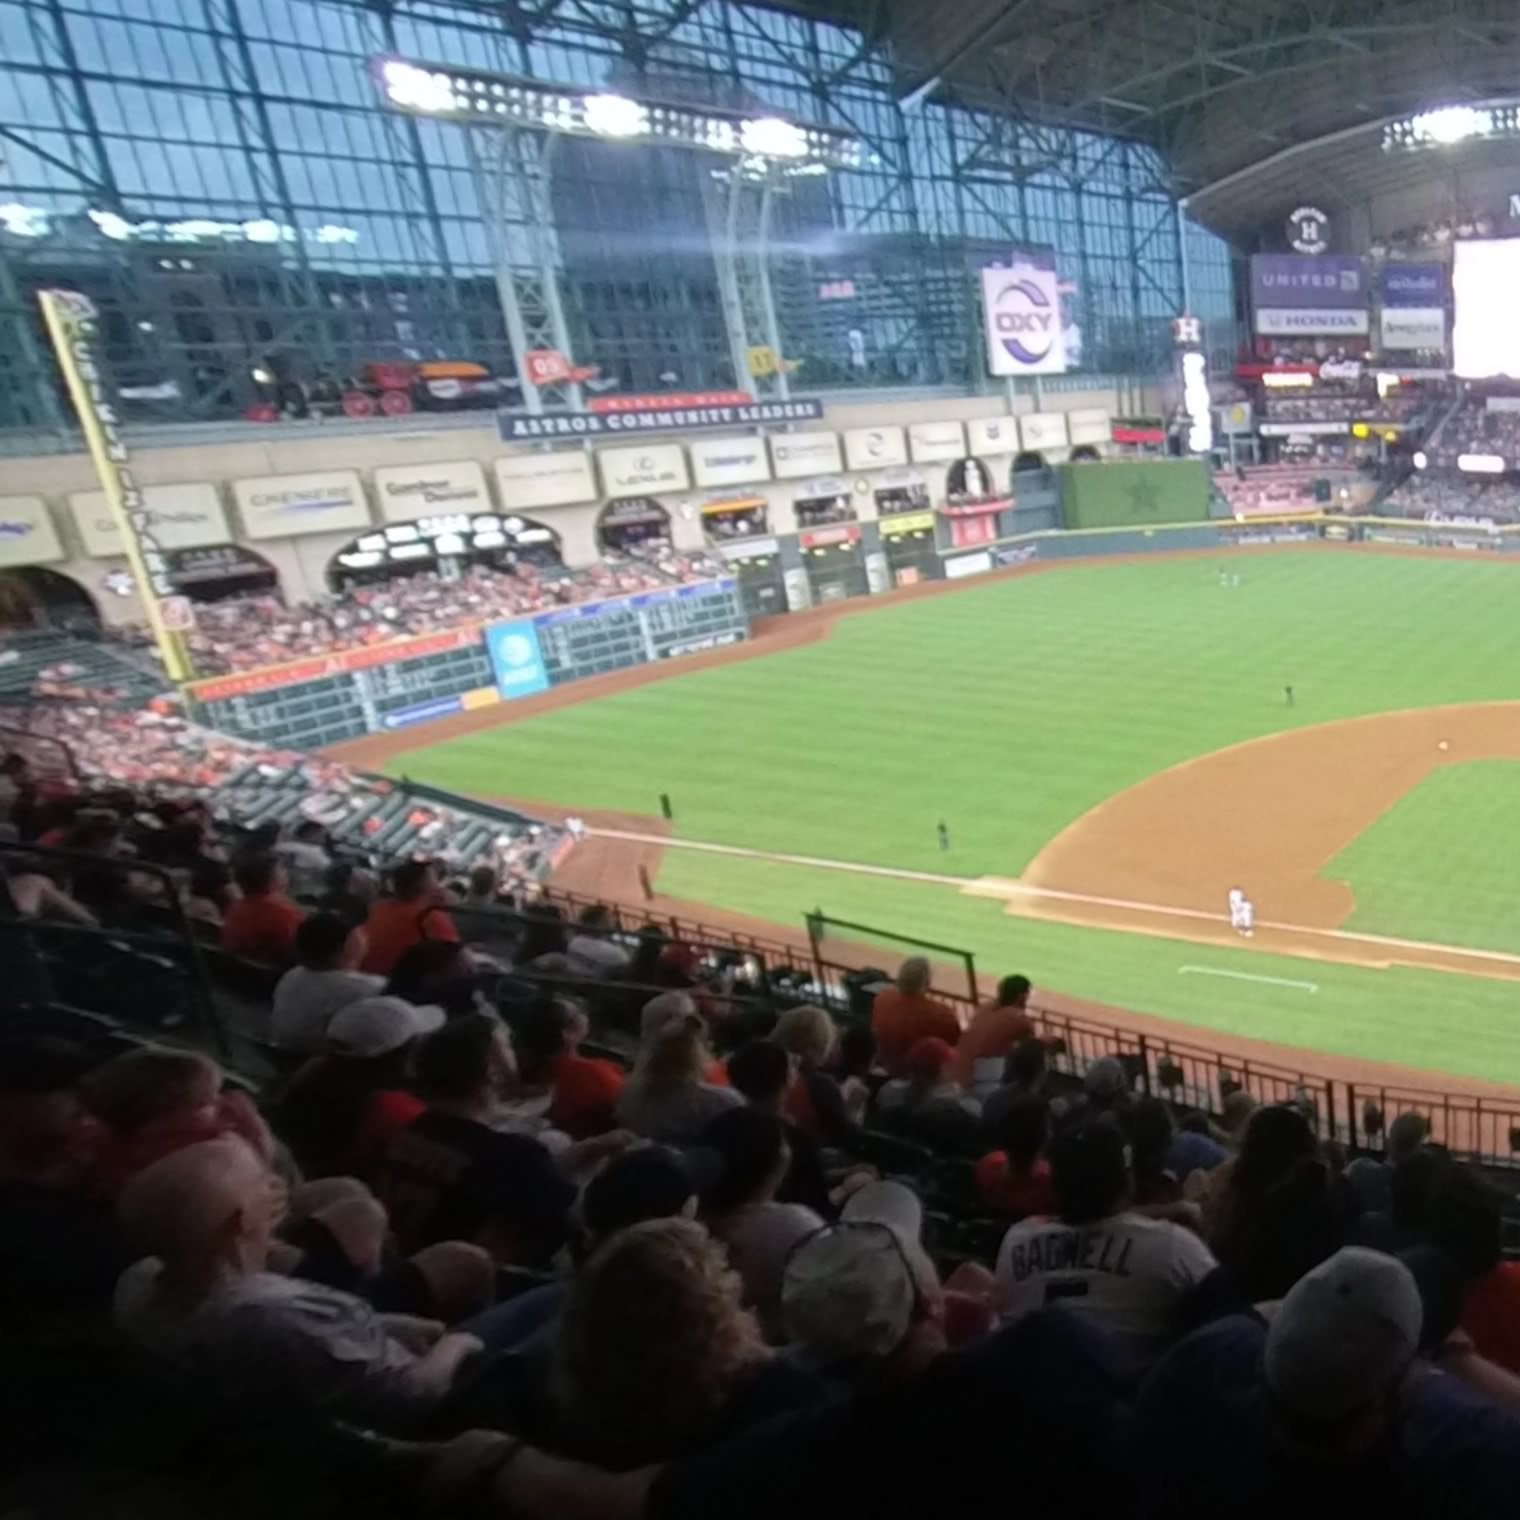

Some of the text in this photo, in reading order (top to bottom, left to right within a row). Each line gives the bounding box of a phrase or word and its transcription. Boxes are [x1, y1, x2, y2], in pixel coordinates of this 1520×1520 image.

[1302, 221, 1318, 239] H
[1262, 275, 1337, 287] UNITED
[995, 311, 1053, 333] OXY
[1286, 315, 1357, 326] HONDA
[514, 402, 816, 435] ASTROS COMMUNITY LEADERS
[616, 471, 676, 486] LEXUS
[1011, 1235, 1133, 1280] BAGWELL
